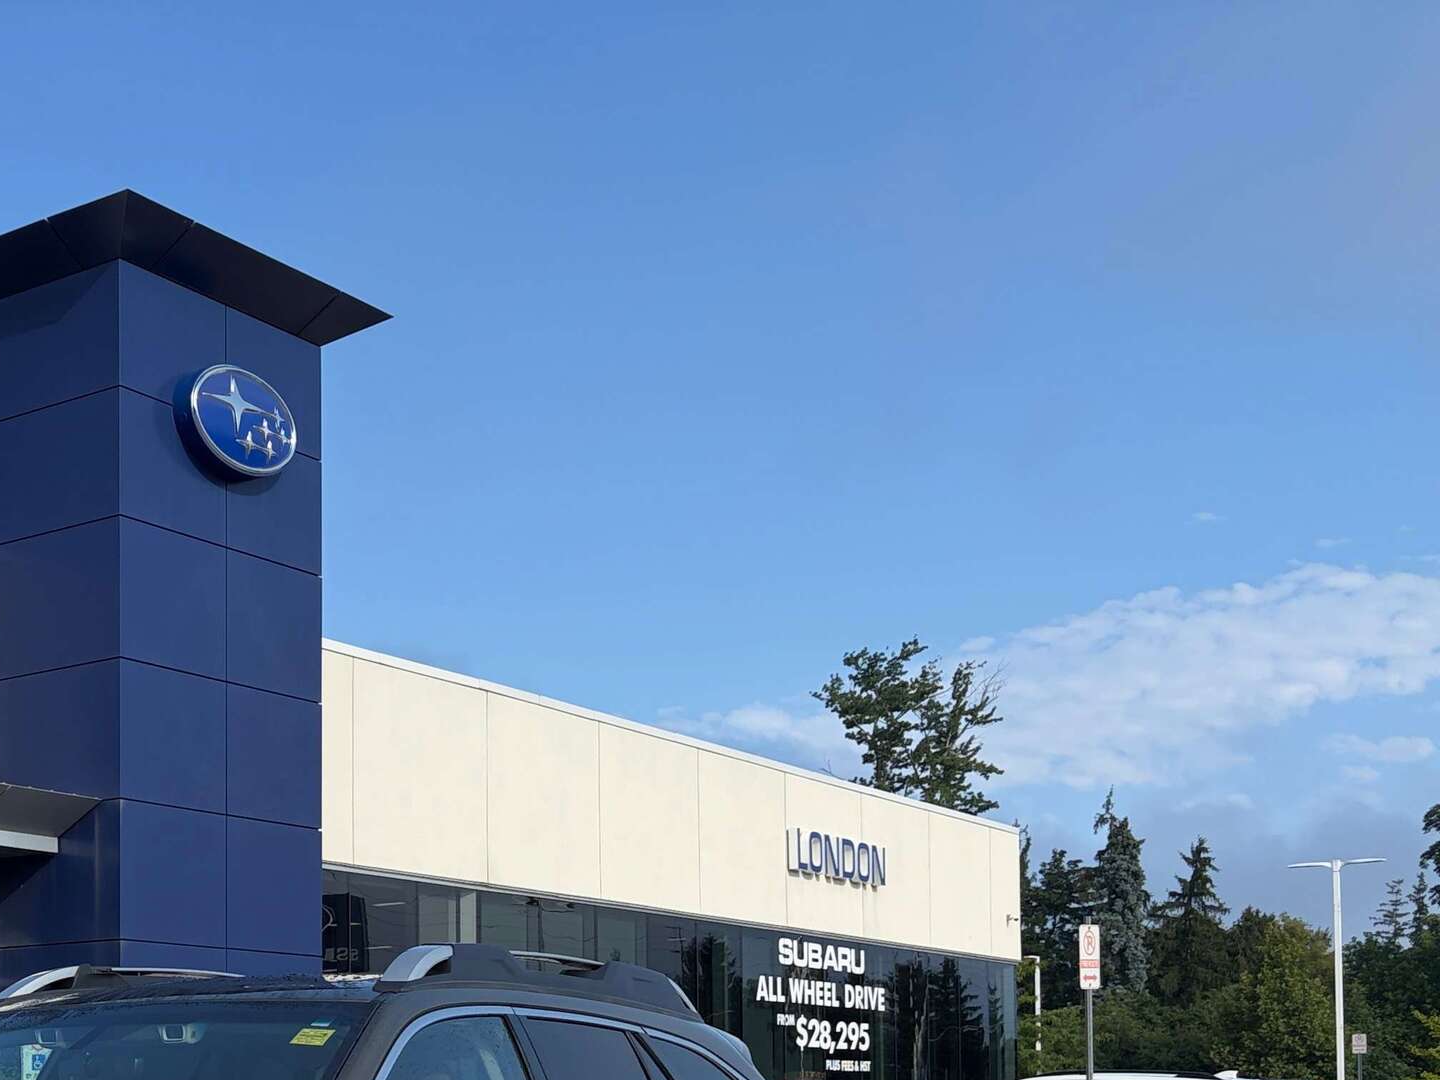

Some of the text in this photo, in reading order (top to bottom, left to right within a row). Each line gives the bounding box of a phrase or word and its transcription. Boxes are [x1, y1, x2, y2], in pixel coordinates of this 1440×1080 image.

[794, 828, 886, 886] LONDON
[778, 937, 865, 975] SUBARU
[756, 975, 886, 1012] ALL WHEEL DRIVE
[776, 1013, 870, 1054] FROM $28,295
[825, 1059, 840, 1071] PLUS
[841, 1060, 854, 1072] FEES
